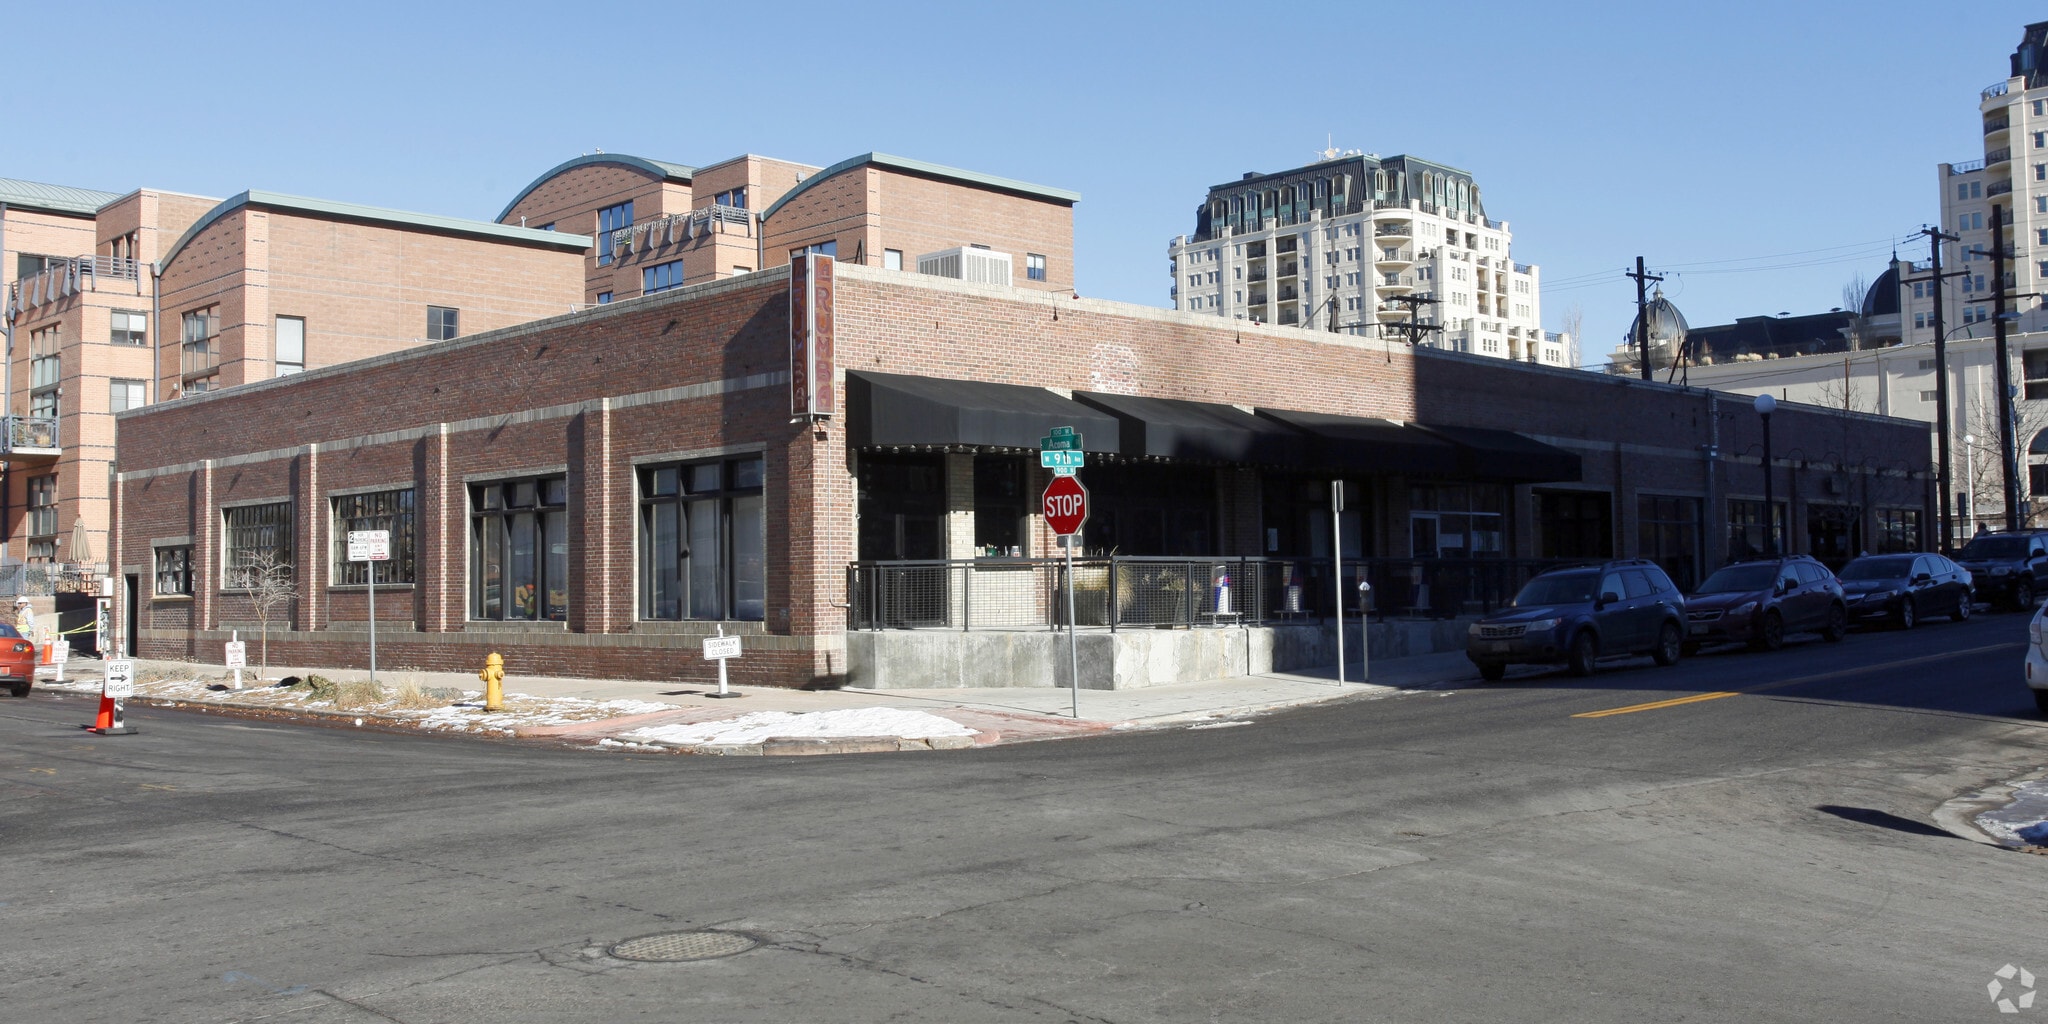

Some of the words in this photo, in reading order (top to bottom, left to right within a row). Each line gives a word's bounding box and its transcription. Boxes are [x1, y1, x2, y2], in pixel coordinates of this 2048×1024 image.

[815, 286, 832, 409] RUMBA
[1048, 439, 1071, 450] Acoma
[1054, 453, 1072, 465] 9th
[1046, 494, 1083, 518] STOP
[707, 639, 737, 648] SIDEWALK
[711, 647, 735, 656] CLOSED
[109, 664, 130, 672] KEEP
[108, 684, 130, 692] RIGHT
